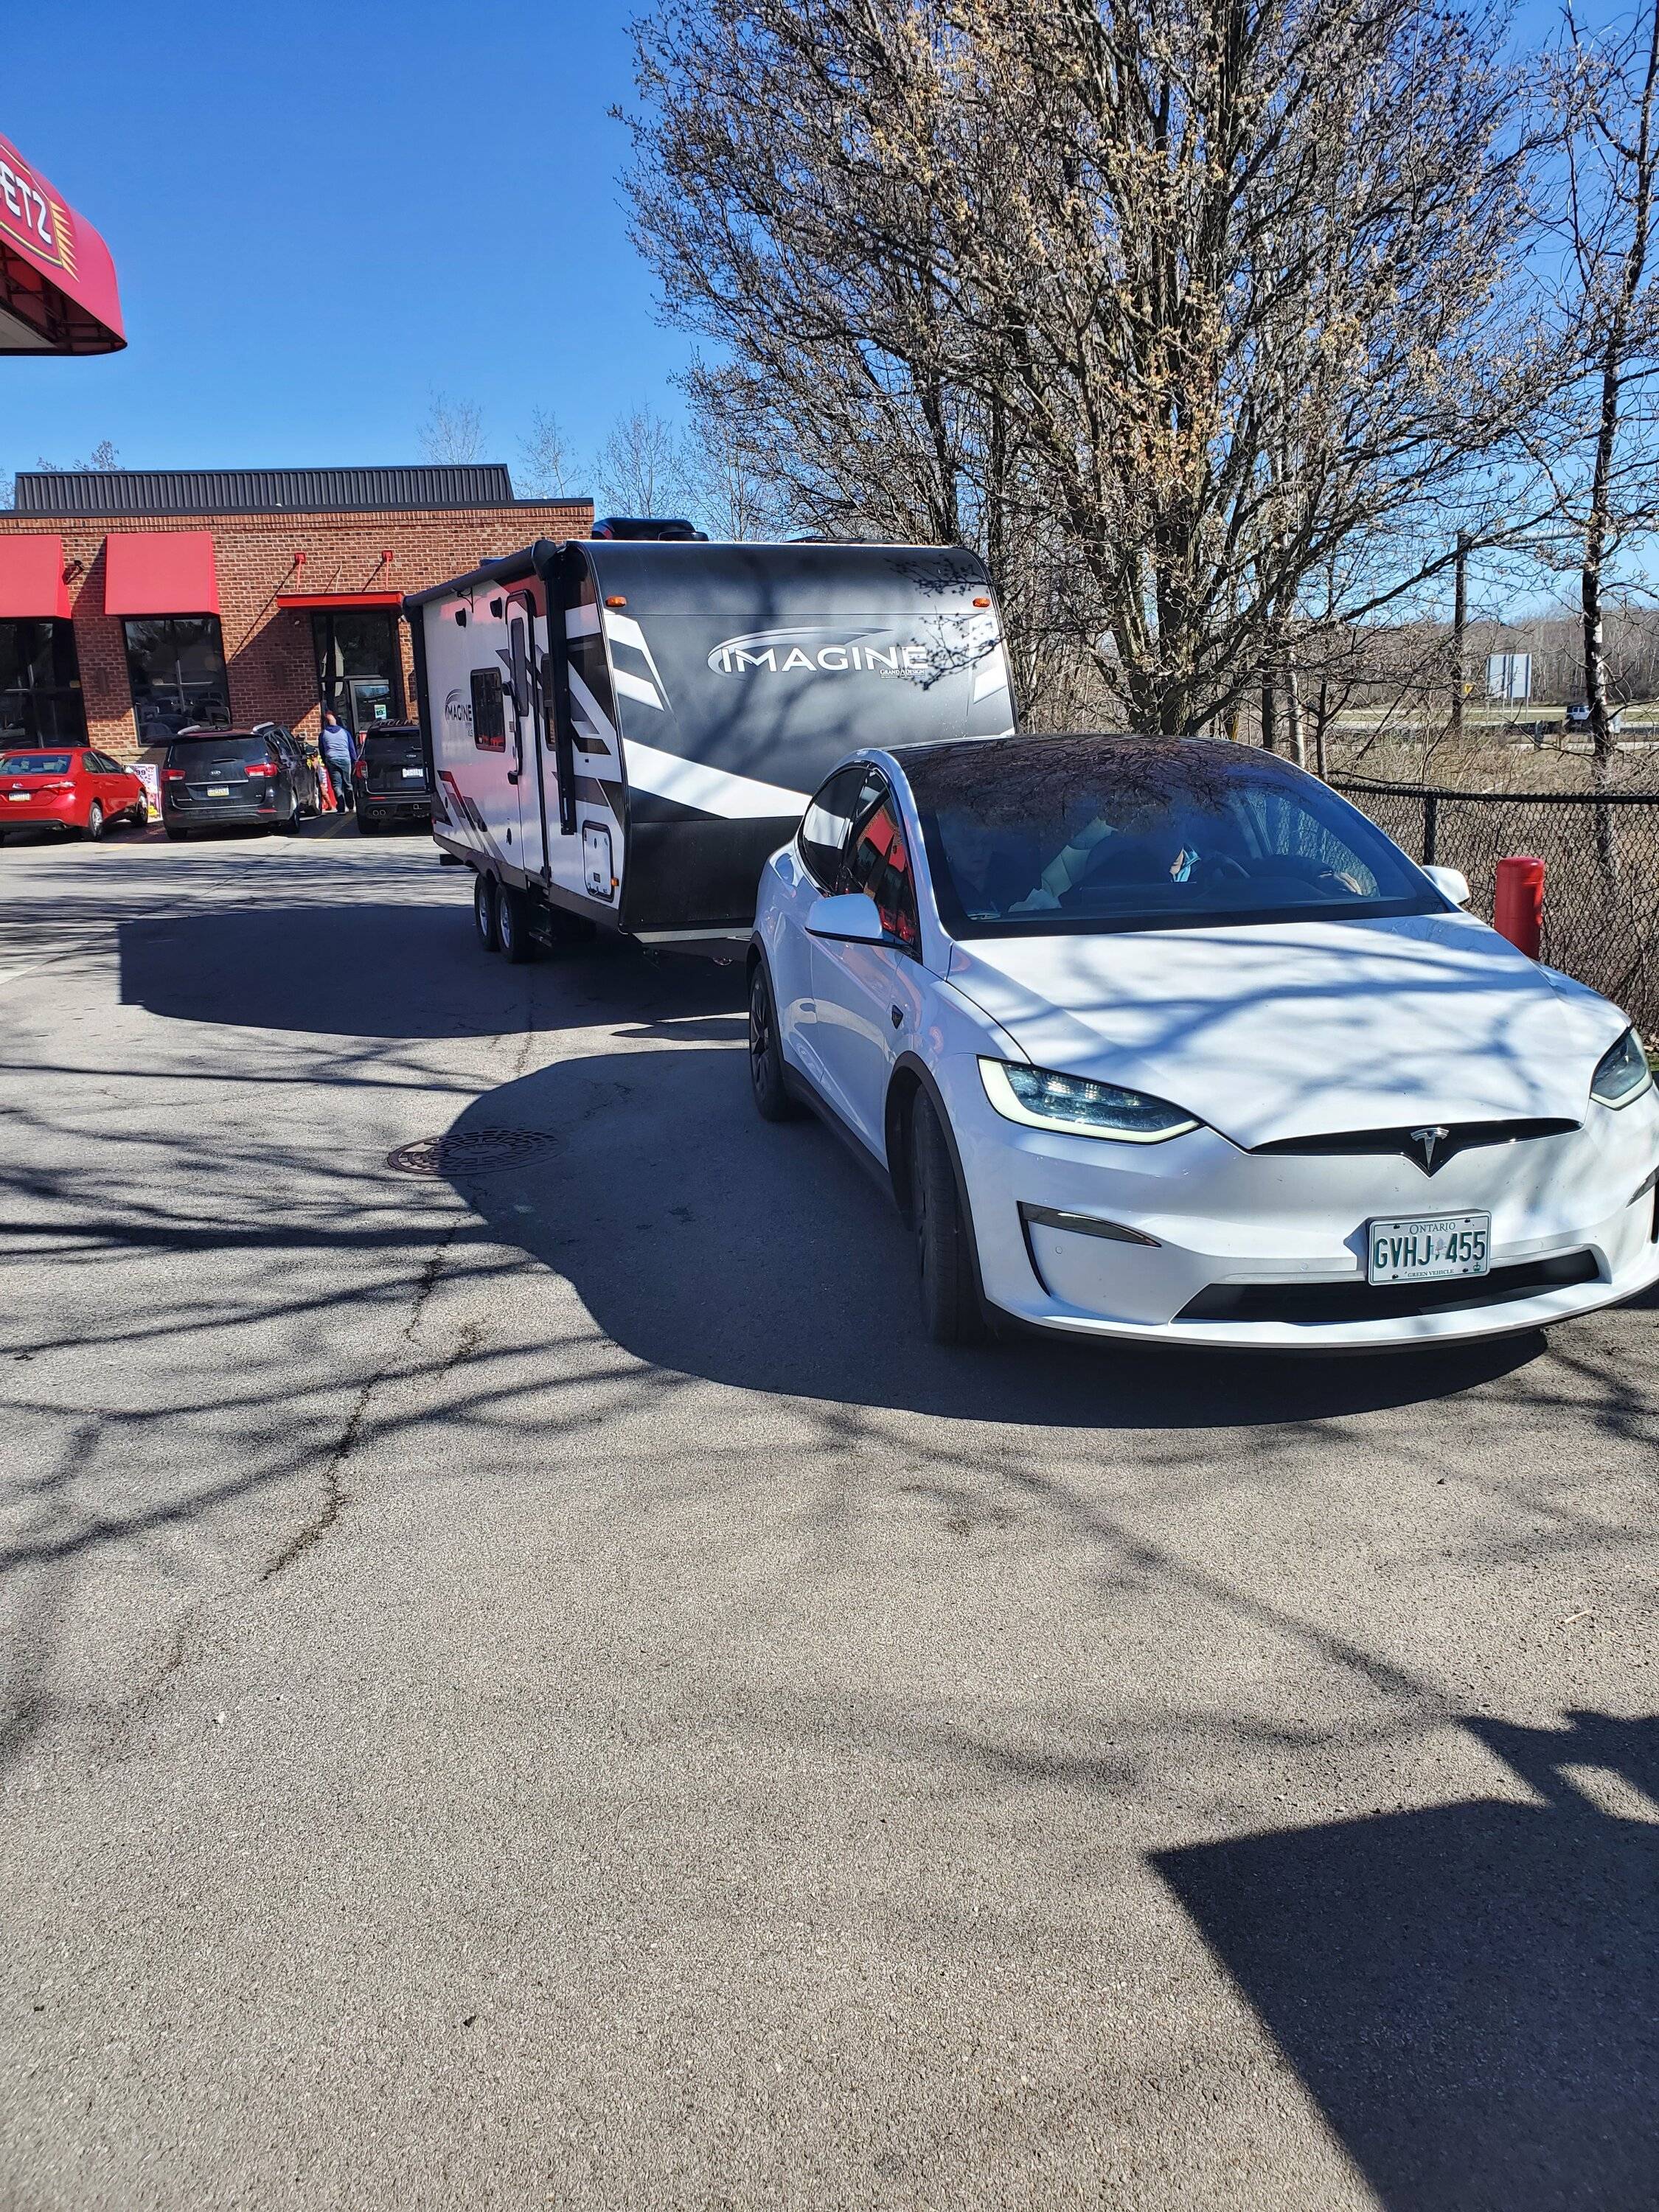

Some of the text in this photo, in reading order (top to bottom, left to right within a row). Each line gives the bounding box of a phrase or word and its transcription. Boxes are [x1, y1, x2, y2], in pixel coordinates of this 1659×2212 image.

[721, 646, 929, 672] IMAGINE
[445, 703, 473, 721] IMAGINE
[1408, 1222, 1456, 1234] ONTARIO
[1374, 1230, 1486, 1269] GVHJ 455
[1428, 1268, 1455, 1276] VEHICLE
